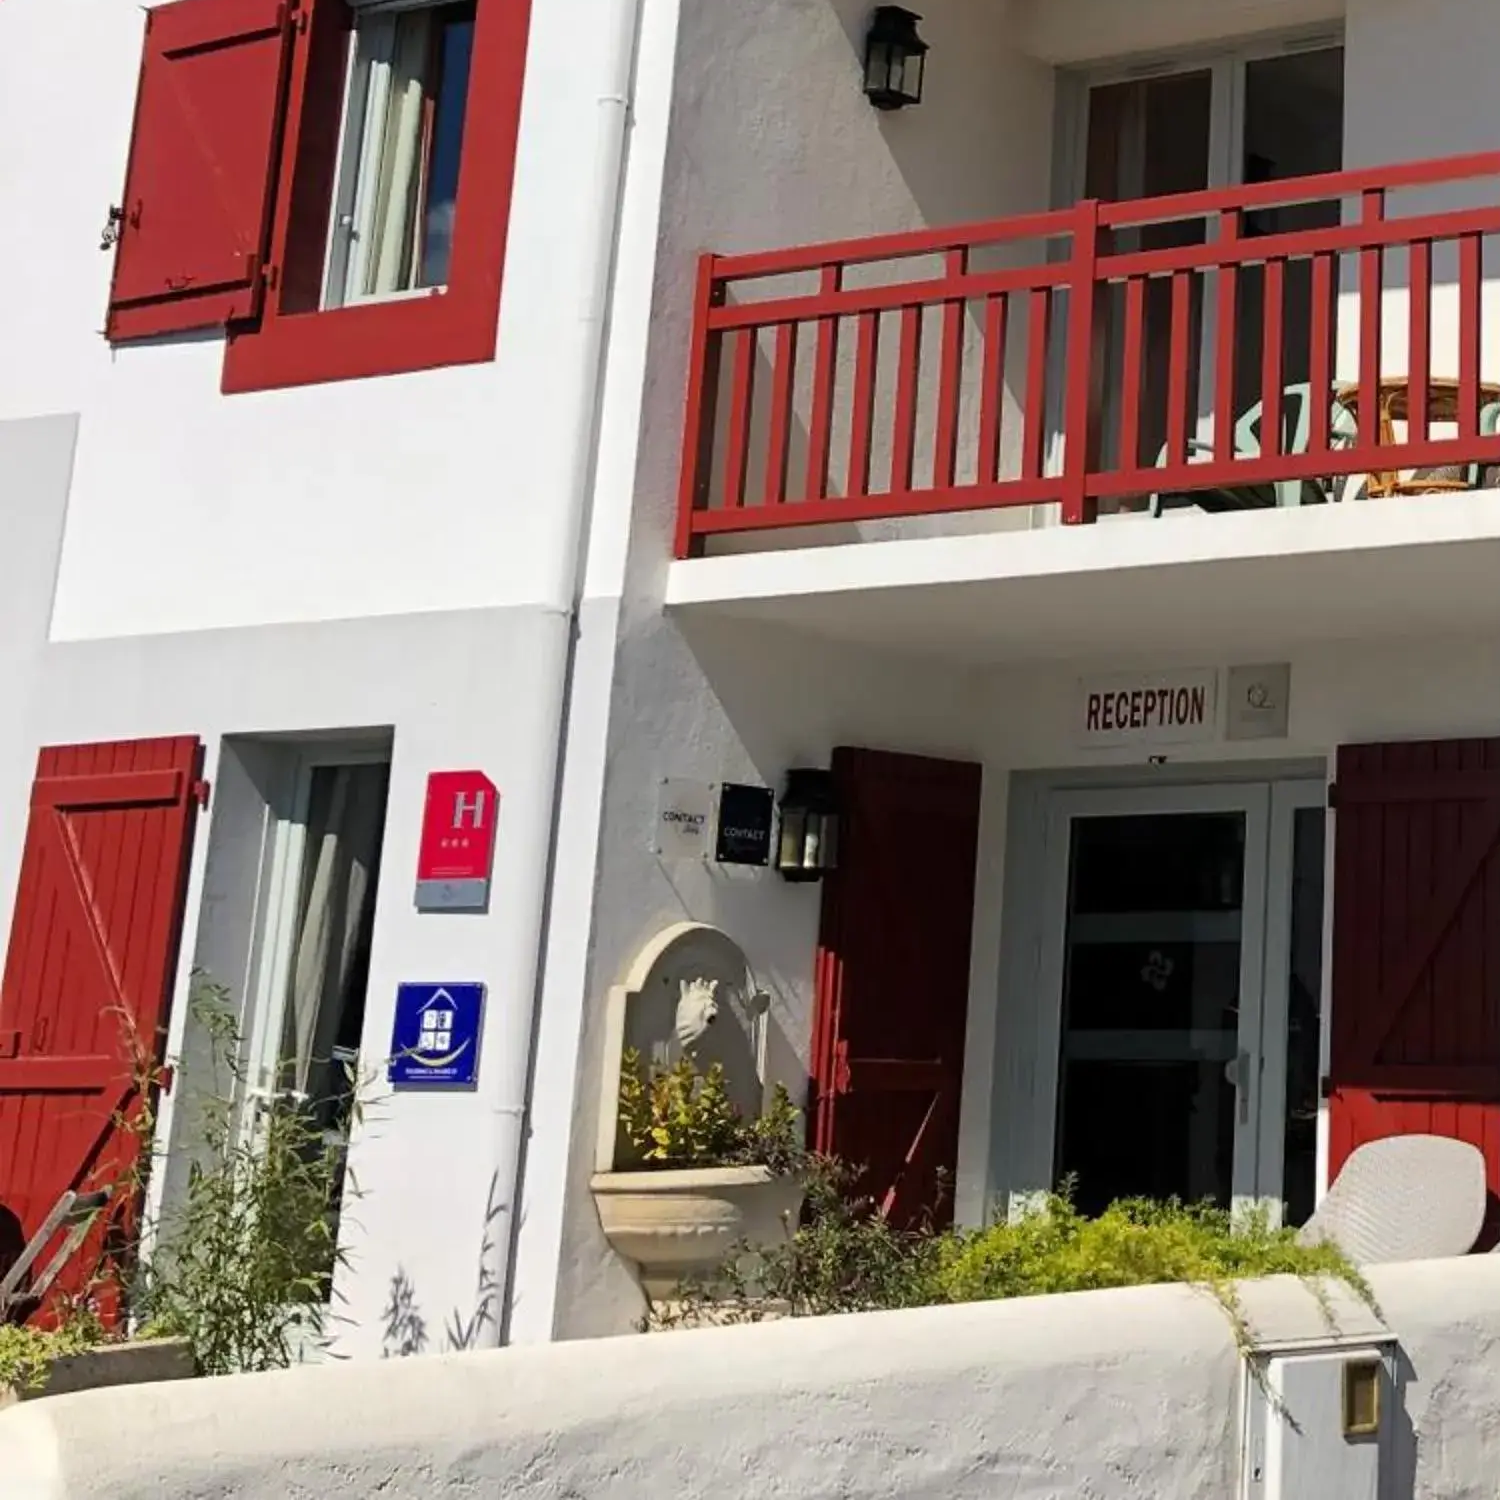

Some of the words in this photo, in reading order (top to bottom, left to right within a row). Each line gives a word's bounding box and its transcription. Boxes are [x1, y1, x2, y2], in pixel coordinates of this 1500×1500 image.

[1087, 686, 1205, 731] RECEPTION
[451, 789, 486, 829] H
[662, 811, 705, 825] CONTACT
[723, 827, 765, 841] CONTACT
